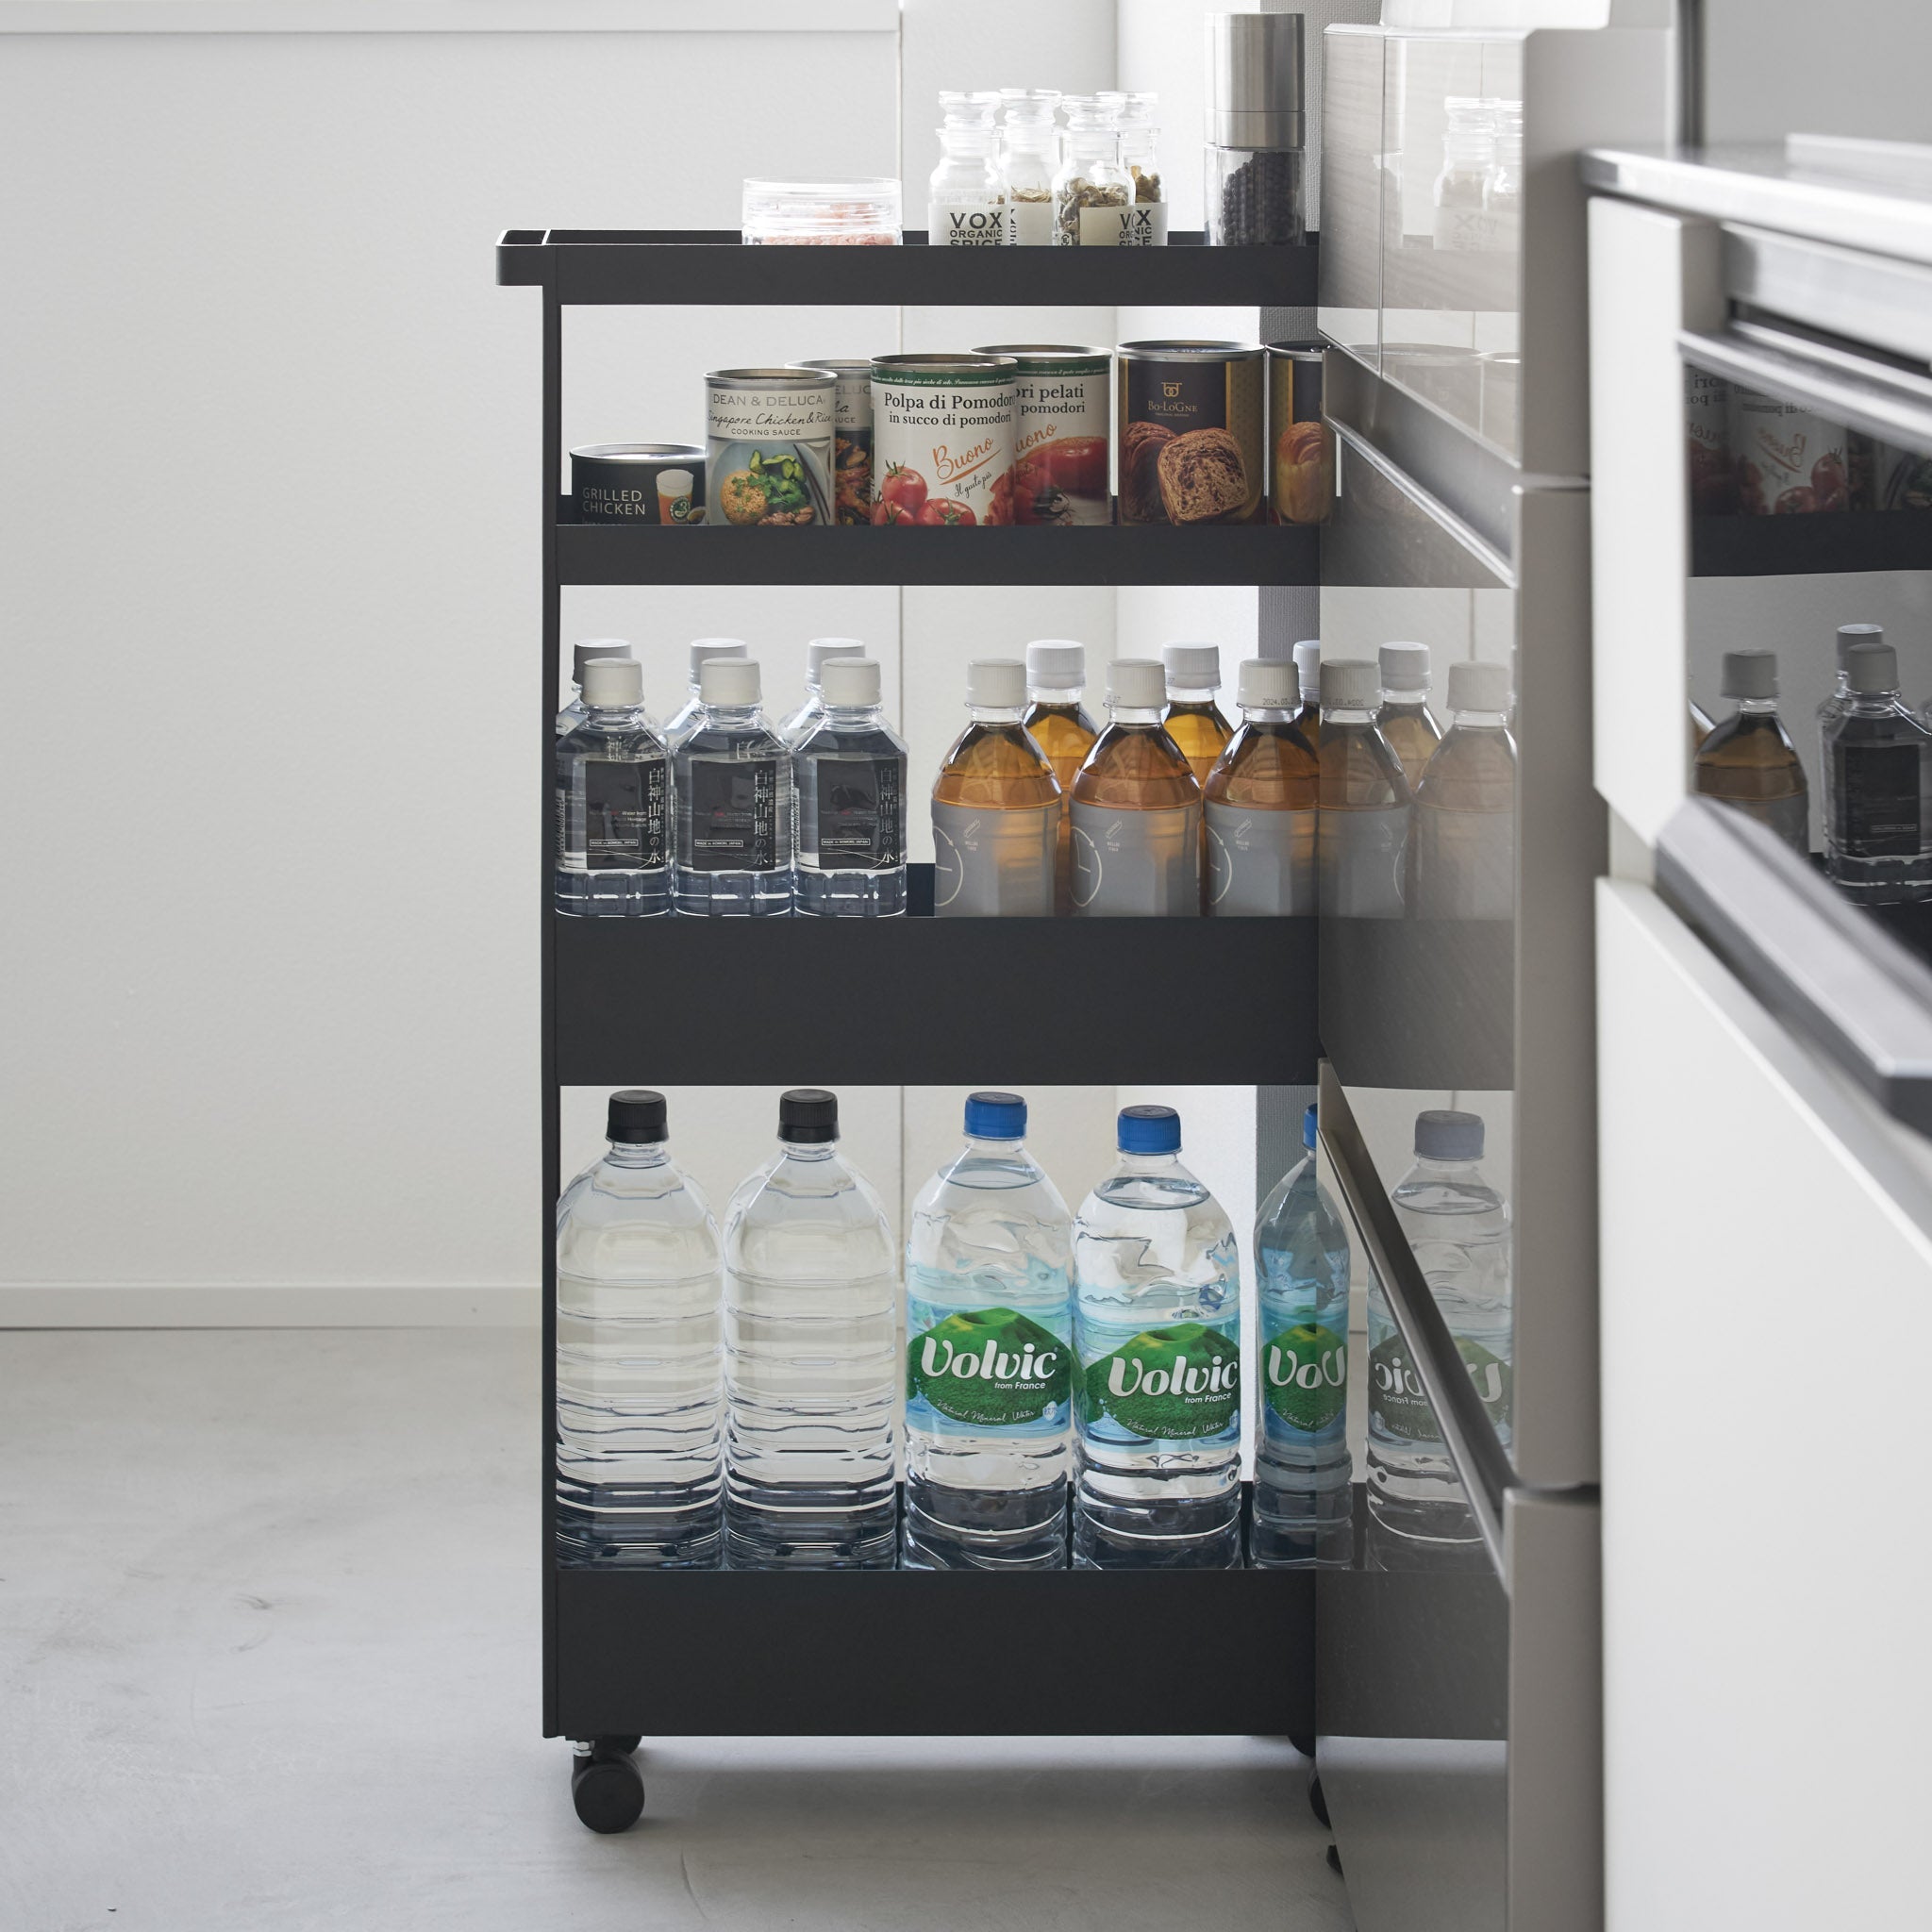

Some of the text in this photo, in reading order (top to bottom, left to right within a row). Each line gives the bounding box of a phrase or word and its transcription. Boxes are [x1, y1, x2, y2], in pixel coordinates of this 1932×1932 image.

[949, 212, 1003, 229] VOX
[950, 229, 1003, 238] ORGANIC
[713, 393, 824, 407] DEAN & DELUCA
[885, 392, 924, 412] Polpa
[929, 394, 946, 409] di
[1039, 383, 1084, 403] pelati
[1021, 401, 1085, 416] pomodori
[890, 410, 1011, 428] in succo di pomodori
[932, 438, 993, 479] Buono
[582, 487, 642, 502] GRILLED
[964, 475, 982, 499] gusto
[582, 501, 646, 515] CHICKEN
[648, 767, 661, 864] 白神山地の水
[754, 770, 769, 865] 白神山地の水
[880, 768, 894, 864] 白神山地の水
[921, 1336, 1058, 1380] Volvic
[994, 1381, 1046, 1390] from France
[1108, 1356, 1238, 1397] Volvic
[1204, 1392, 1232, 1404] France
[937, 1398, 971, 1418] Natural
[1126, 1418, 1160, 1435] Natural
